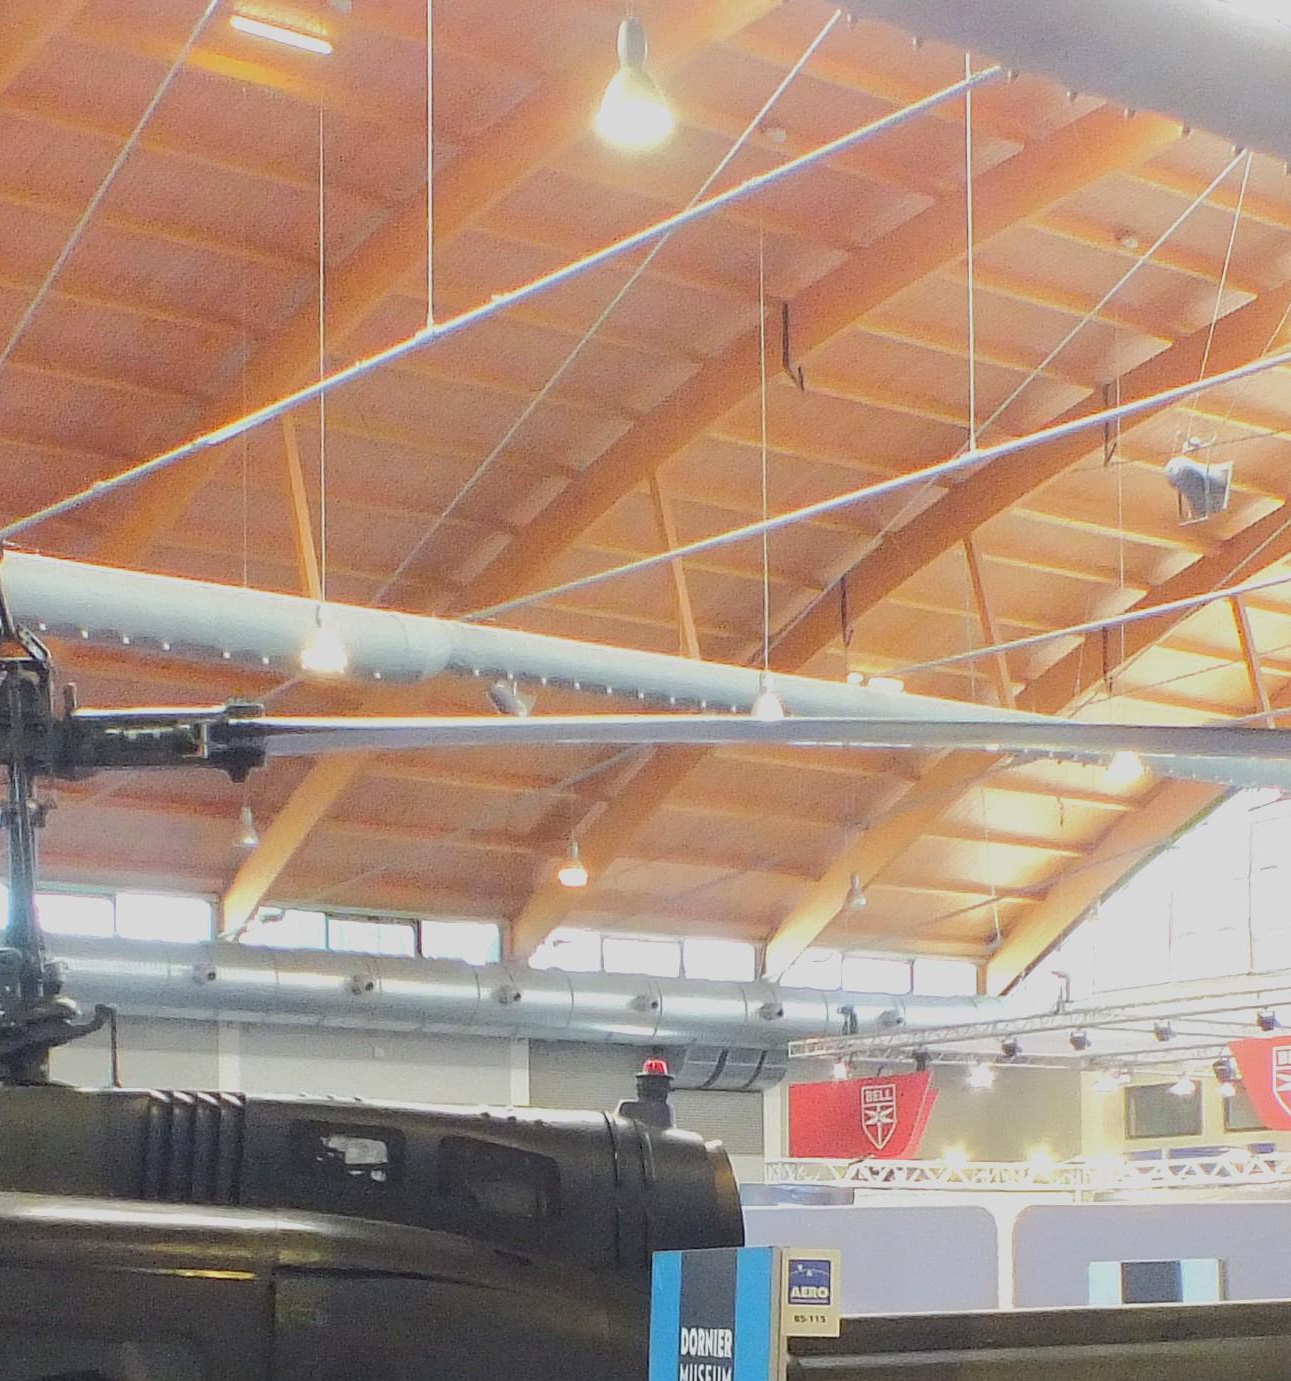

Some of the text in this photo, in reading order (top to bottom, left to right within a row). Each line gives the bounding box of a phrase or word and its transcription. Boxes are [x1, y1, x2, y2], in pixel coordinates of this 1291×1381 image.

[865, 1088, 893, 1103] BELL
[790, 1286, 829, 1298] AERO
[680, 1326, 733, 1358] DORNIER
